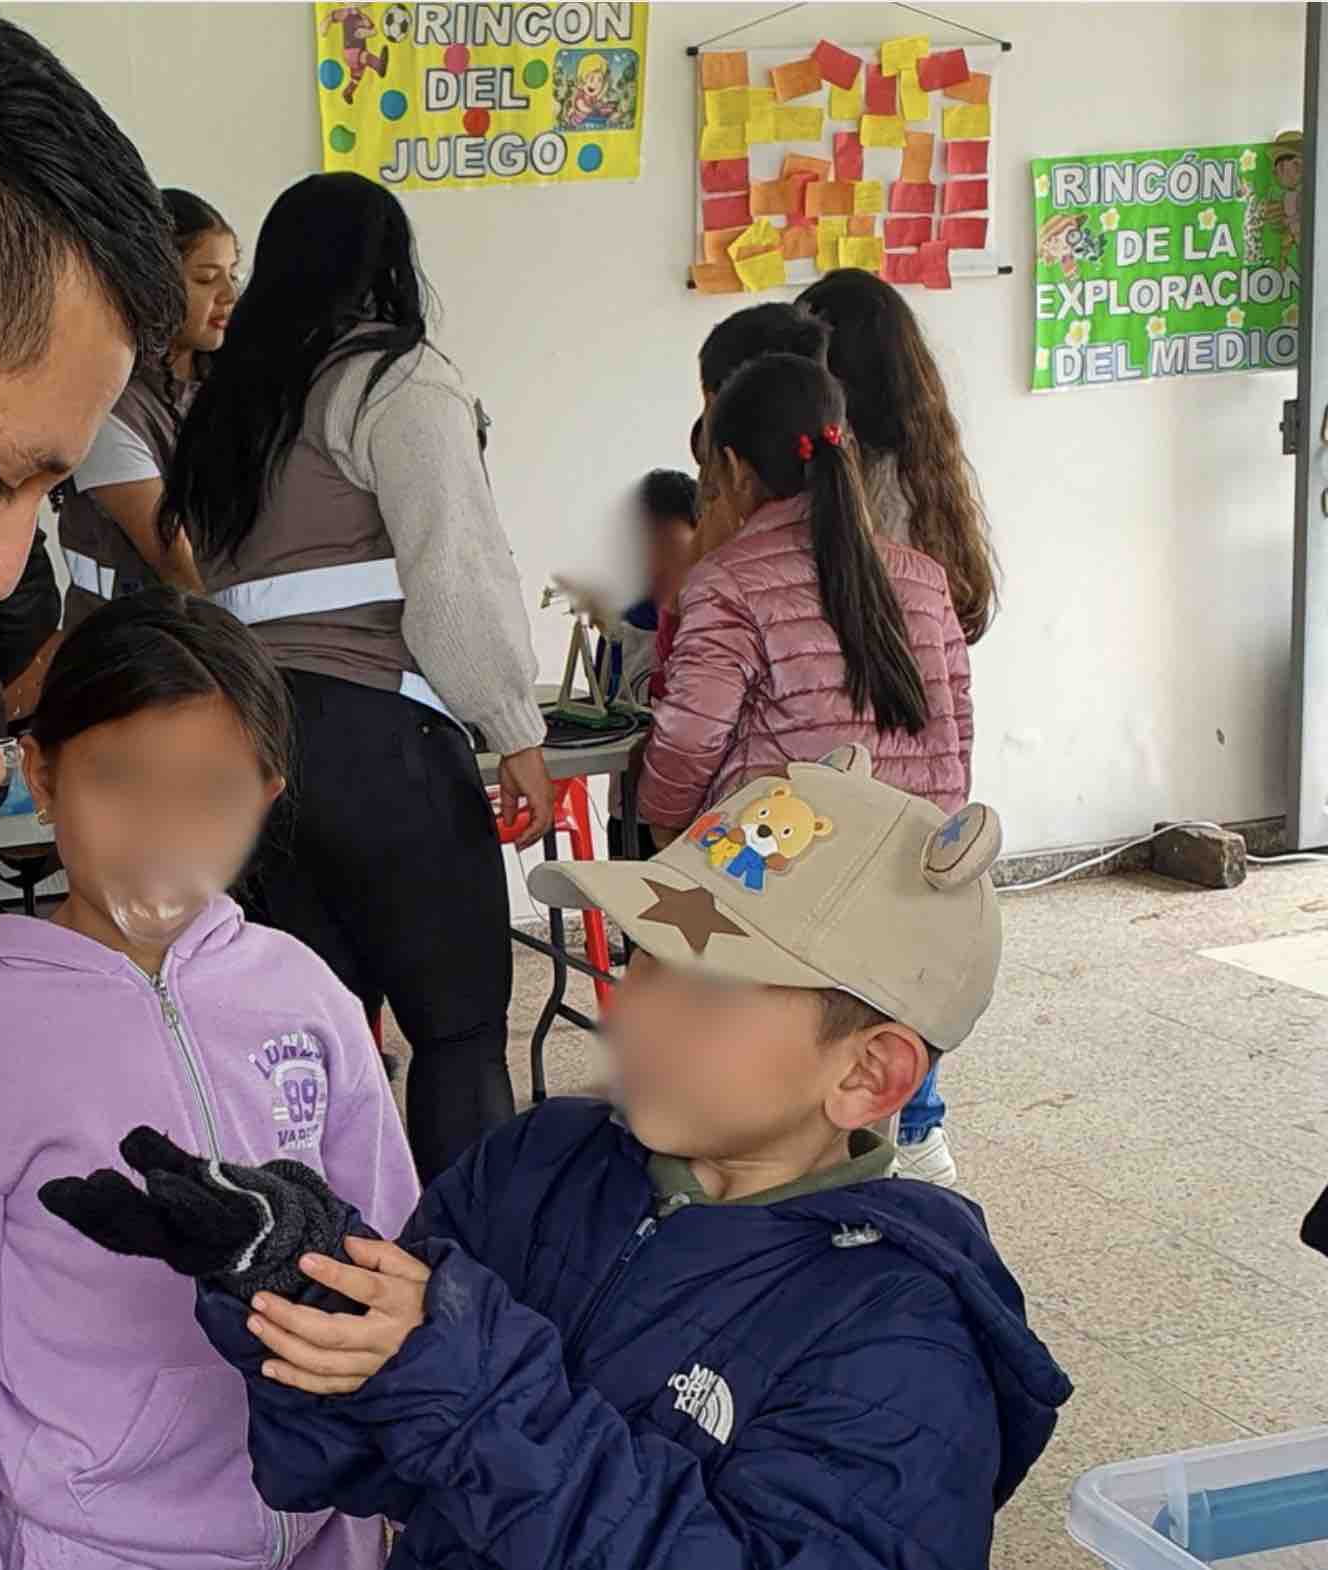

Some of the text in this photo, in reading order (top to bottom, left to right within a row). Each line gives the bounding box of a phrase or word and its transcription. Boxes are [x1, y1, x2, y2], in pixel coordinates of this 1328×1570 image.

[425, 67, 530, 111] DEL
[380, 131, 568, 183] JUEGO
[1053, 153, 1235, 208] RINCÓN
[1116, 223, 1238, 266] DE LA
[1054, 327, 1299, 387] DEL MEDIO
